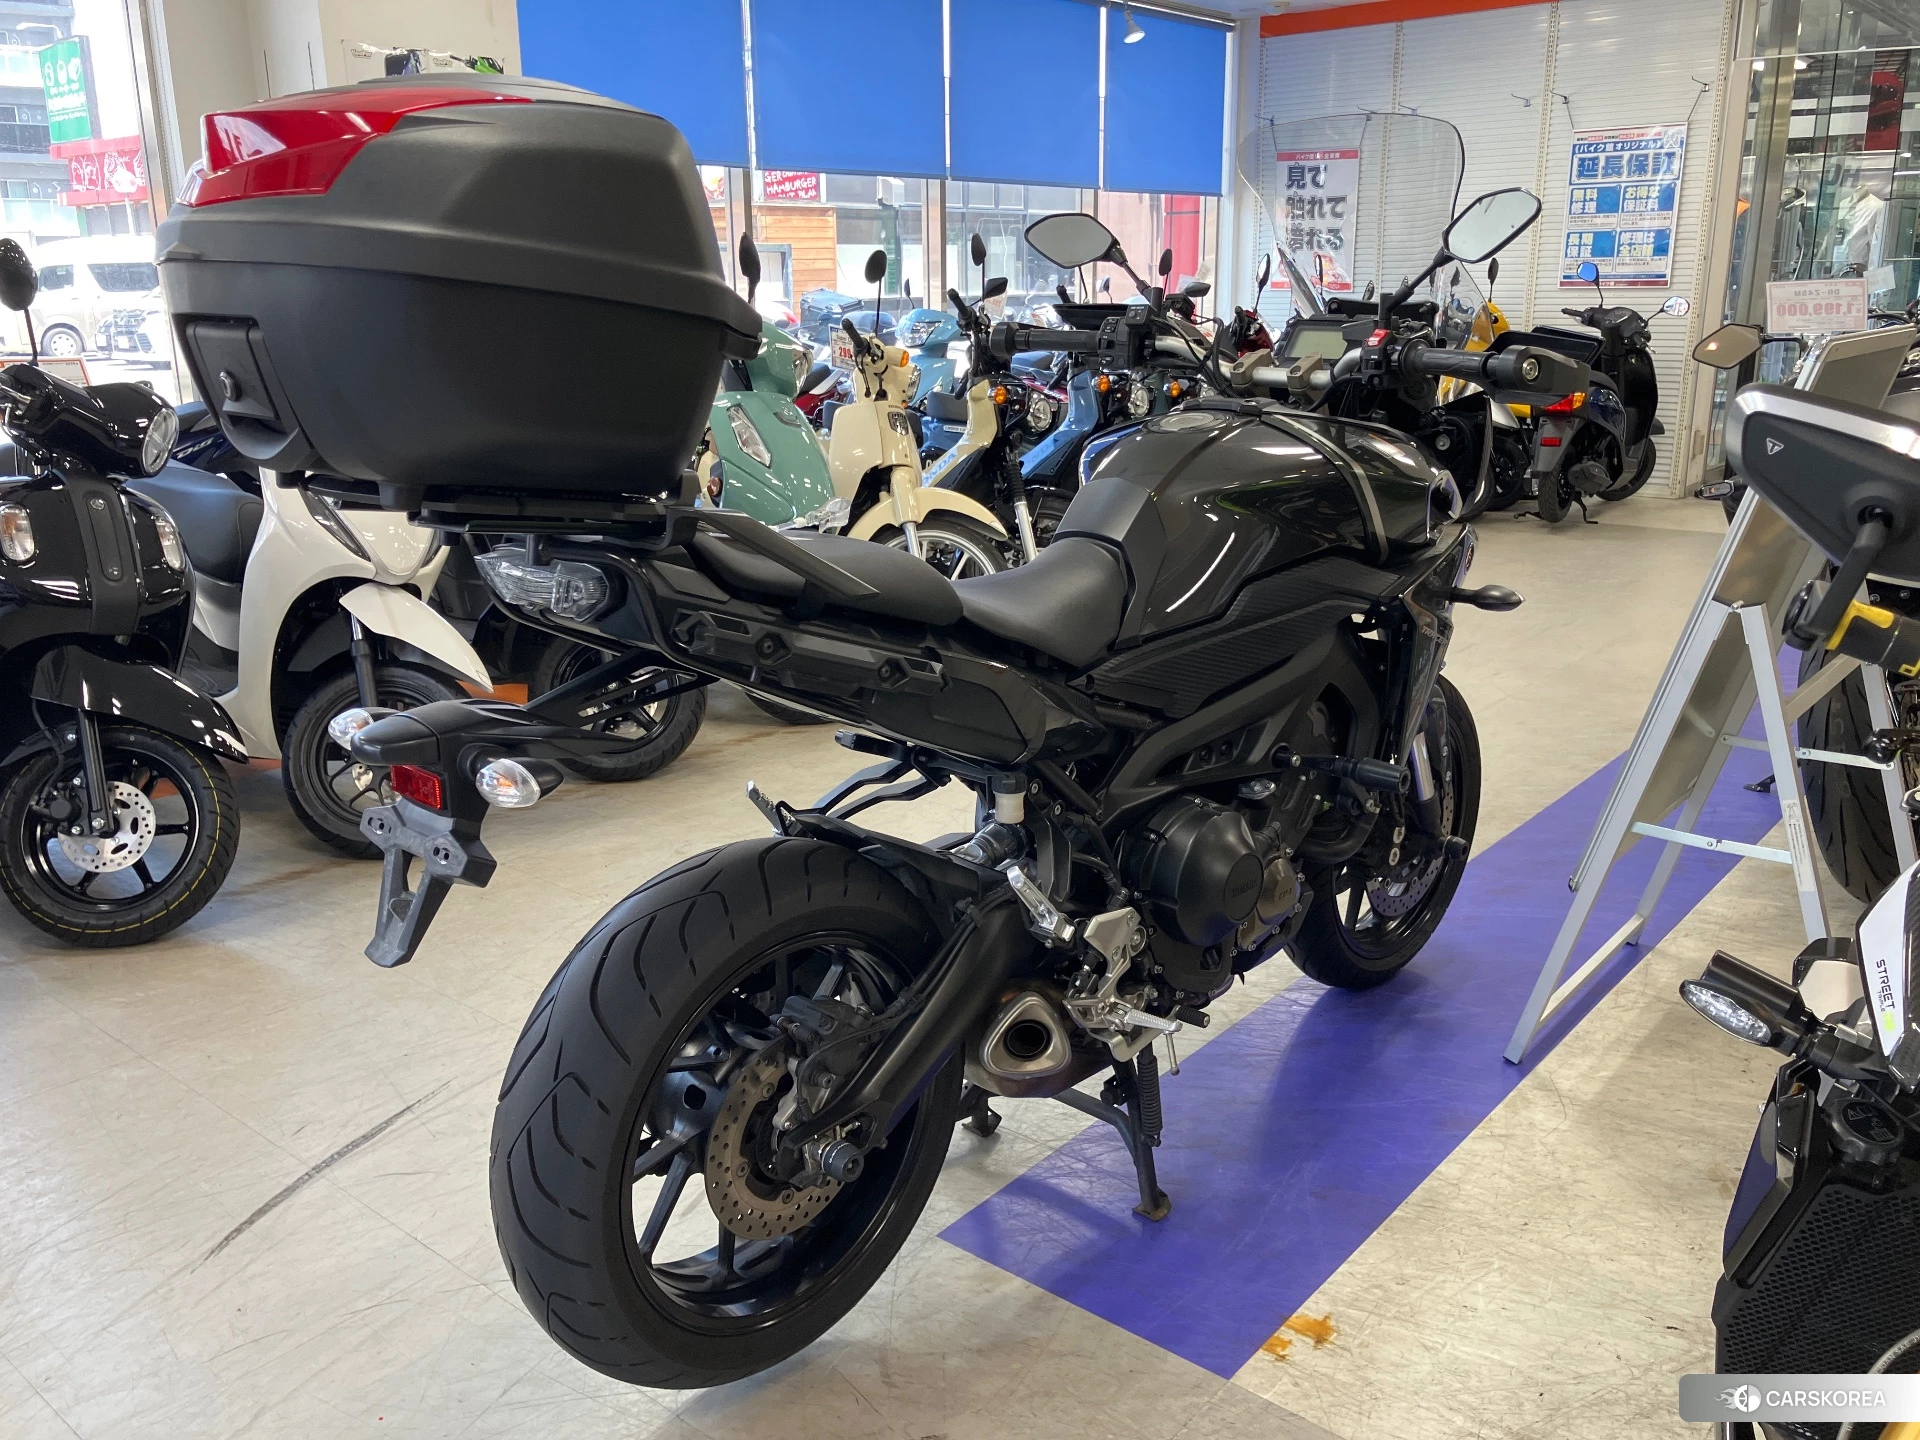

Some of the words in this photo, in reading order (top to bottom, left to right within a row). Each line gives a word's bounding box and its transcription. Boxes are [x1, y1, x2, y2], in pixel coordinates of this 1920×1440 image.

[1576, 151, 1677, 180] 延長保証
[766, 176, 817, 195] HAMBURGER
[1625, 186, 1660, 199] お得な
[1572, 188, 1598, 201] 無料
[1571, 201, 1597, 215] 修理
[1623, 199, 1659, 213] 保証料
[1568, 233, 1594, 246] 長期
[1620, 231, 1656, 245] 修理は
[1567, 246, 1593, 258] 保証
[1876, 959, 1895, 1009] STREET
